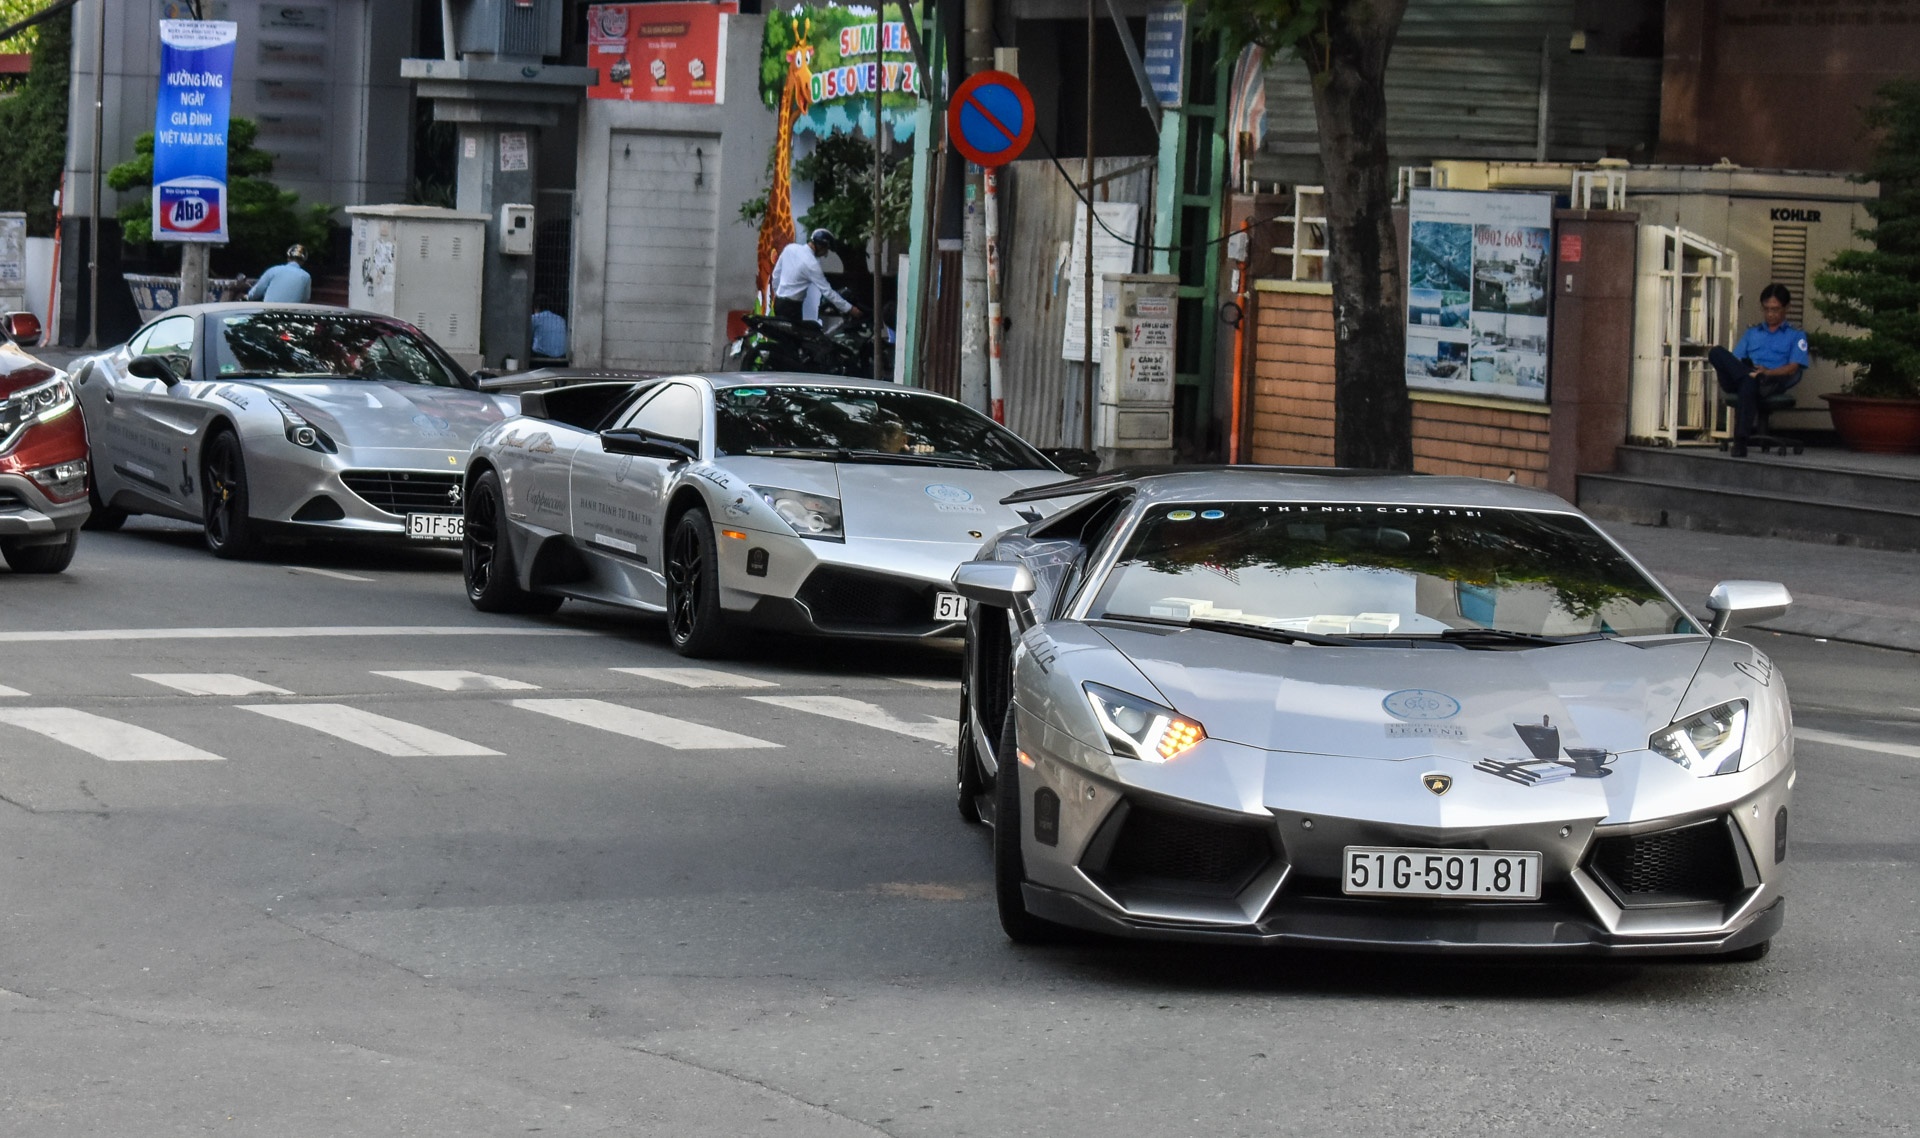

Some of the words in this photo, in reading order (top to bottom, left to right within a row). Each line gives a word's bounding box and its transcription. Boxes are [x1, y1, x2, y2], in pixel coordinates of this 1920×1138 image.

[840, 21, 912, 57] SUMMER
[167, 69, 200, 86] HƯỞNG
[202, 71, 223, 88] ỨNG
[811, 61, 898, 103] DISCOVERY
[181, 90, 205, 106] NGÀY
[171, 112, 188, 125] GIA
[189, 110, 213, 126] ĐÌNH
[160, 129, 179, 147] VIỆT
[180, 131, 202, 145] NAM
[174, 200, 204, 222] Aba
[1770, 207, 1821, 222] KOHLER
[1504, 231, 1523, 247] 668
[940, 596, 967, 618] 51
[1390, 727, 1464, 736] LEGEND
[1351, 853, 1527, 893] 51G-591.81
